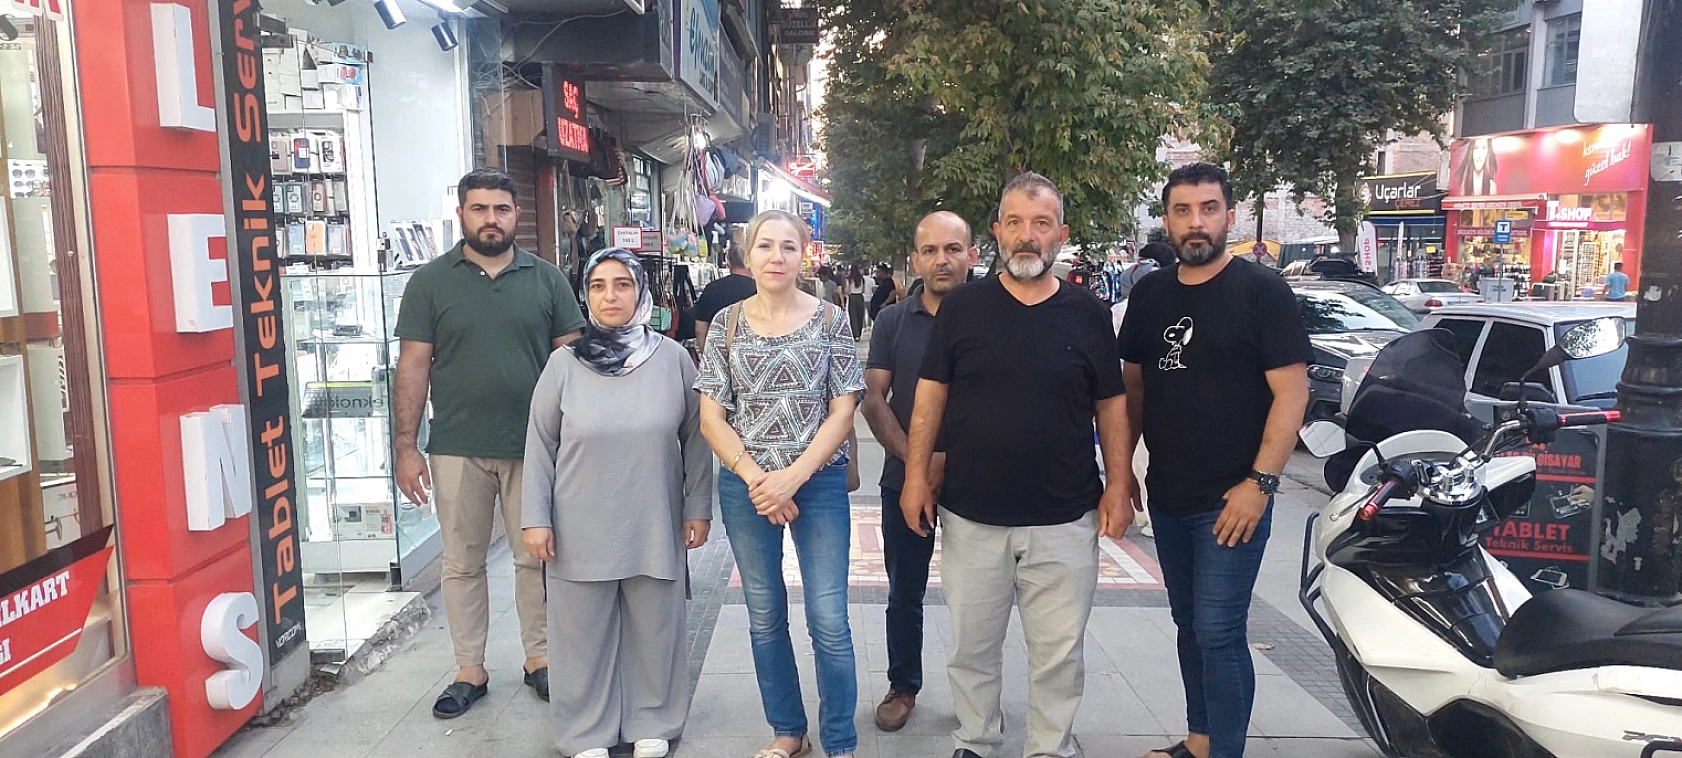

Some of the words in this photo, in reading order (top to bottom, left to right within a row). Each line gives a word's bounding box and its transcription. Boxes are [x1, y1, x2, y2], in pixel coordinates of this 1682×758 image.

[1375, 182, 1421, 203] Uçarlar
[242, 173, 280, 397] Teknik
[260, 415, 298, 625] Tablet
[1485, 537, 1529, 550] Teknik
[1534, 541, 1574, 553] Servis
[0, 570, 70, 628] LKART
